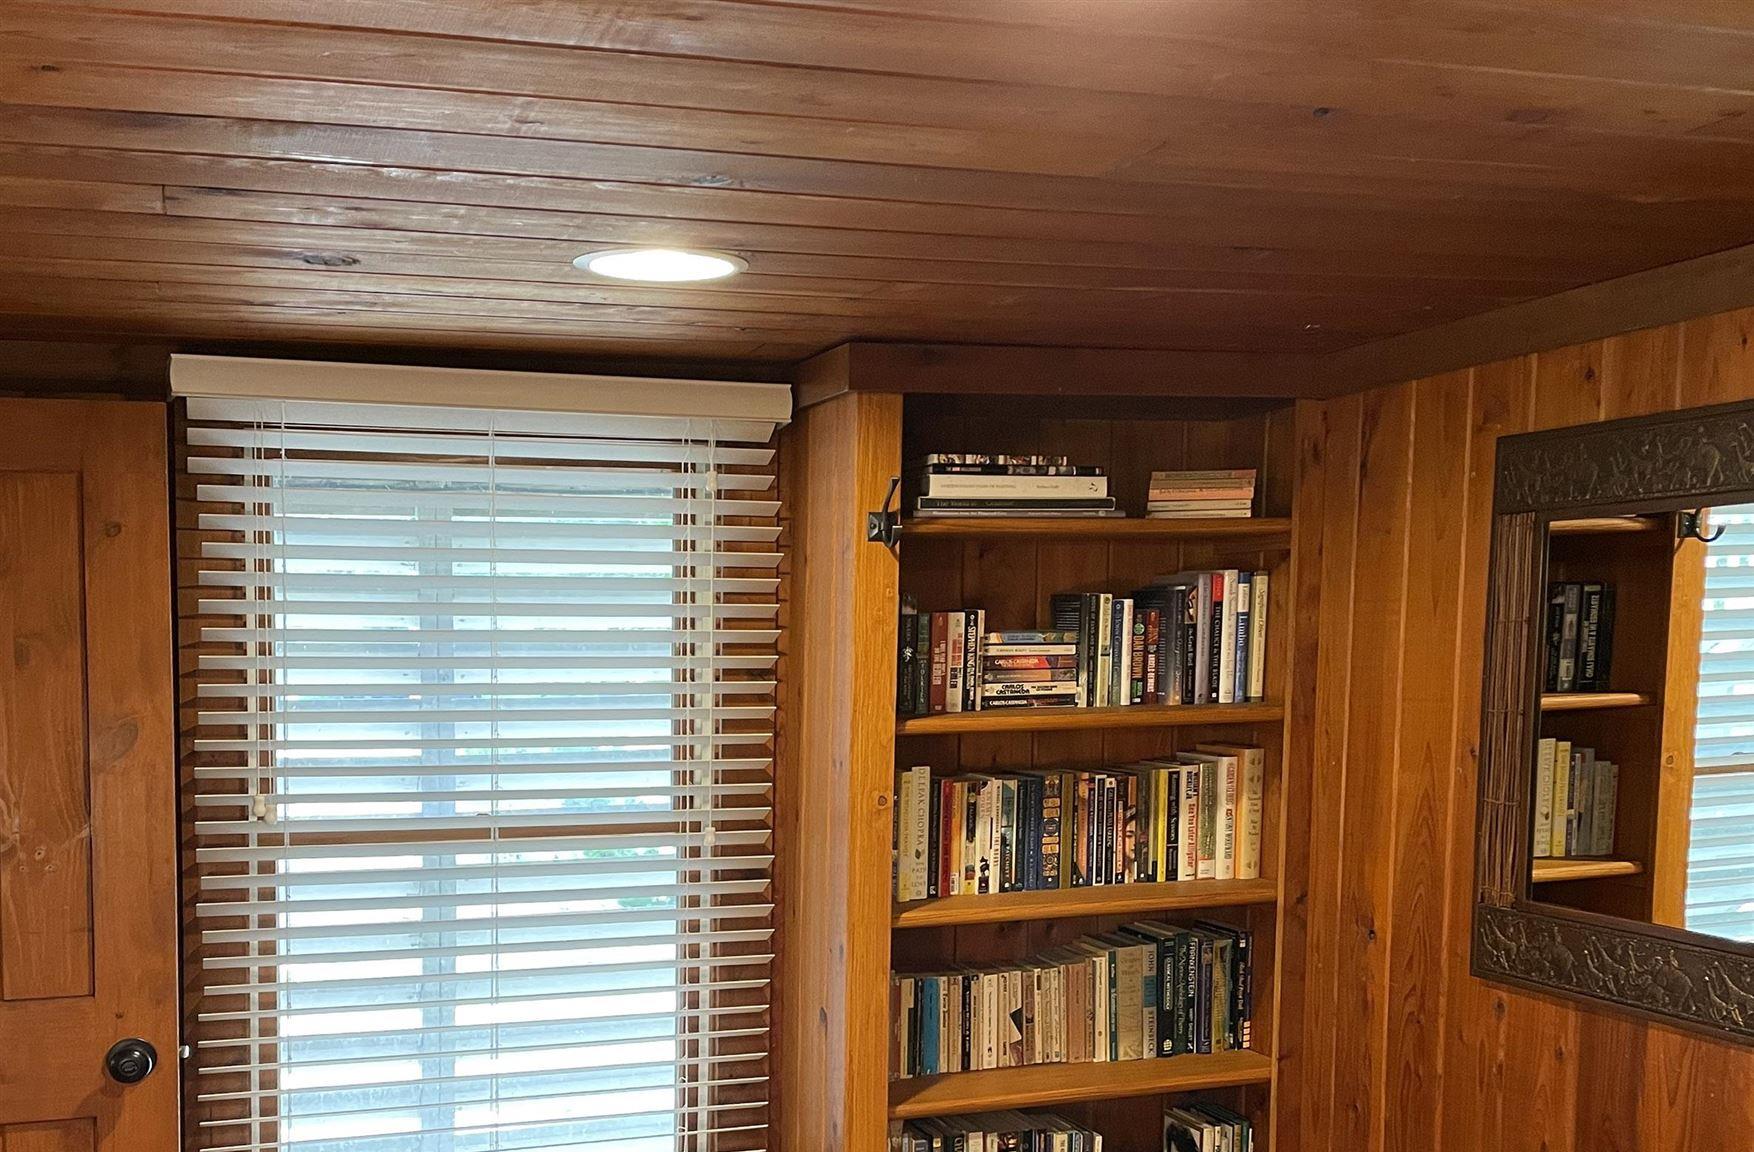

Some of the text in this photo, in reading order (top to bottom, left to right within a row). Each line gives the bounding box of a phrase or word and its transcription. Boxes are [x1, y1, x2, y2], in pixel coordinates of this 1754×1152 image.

[967, 626, 976, 652] STEPHEN
[1213, 619, 1221, 647] CHALICE
[1238, 615, 1248, 646] Limbo
[967, 653, 976, 668] KING
[1132, 635, 1143, 679] DAN BROWN
[1212, 655, 1220, 667] THE
[1211, 668, 1219, 688] BLADE
[996, 688, 1030, 696] CASTANEDA
[1170, 773, 1178, 800] Running
[916, 768, 926, 846] DEEPAK CHOPRA
[1169, 817, 1177, 842] Scissors
[1187, 826, 1195, 841] Later
[1186, 842, 1195, 868] Alligator
[1187, 942, 1195, 997] FRANKENSTEIN
